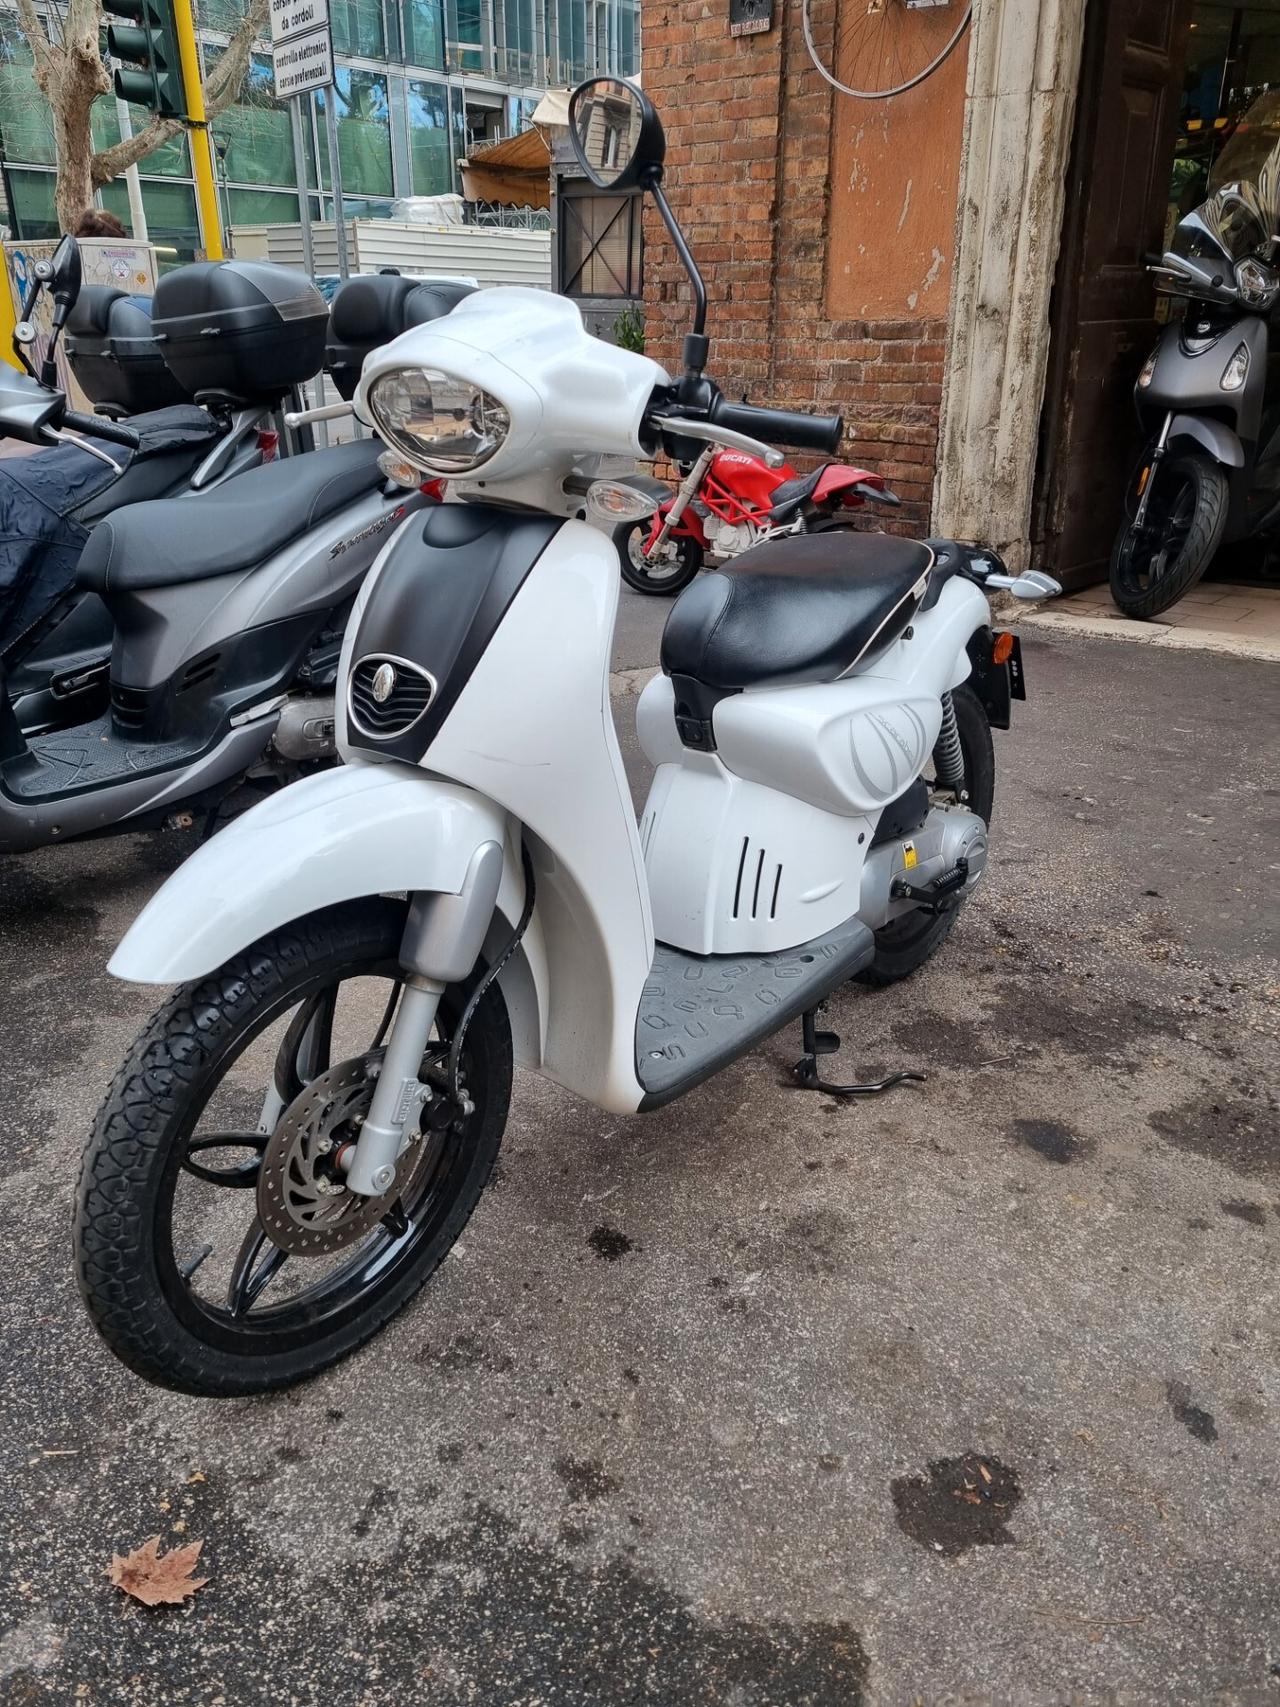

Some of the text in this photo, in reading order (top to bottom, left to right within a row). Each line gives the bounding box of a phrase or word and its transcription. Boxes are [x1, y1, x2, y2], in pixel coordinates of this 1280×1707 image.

[281, 4, 314, 31] da cordoli
[276, 40, 327, 68] controllo elettronico
[295, 61, 327, 86] preferenziali
[719, 454, 753, 465] DUCATI
